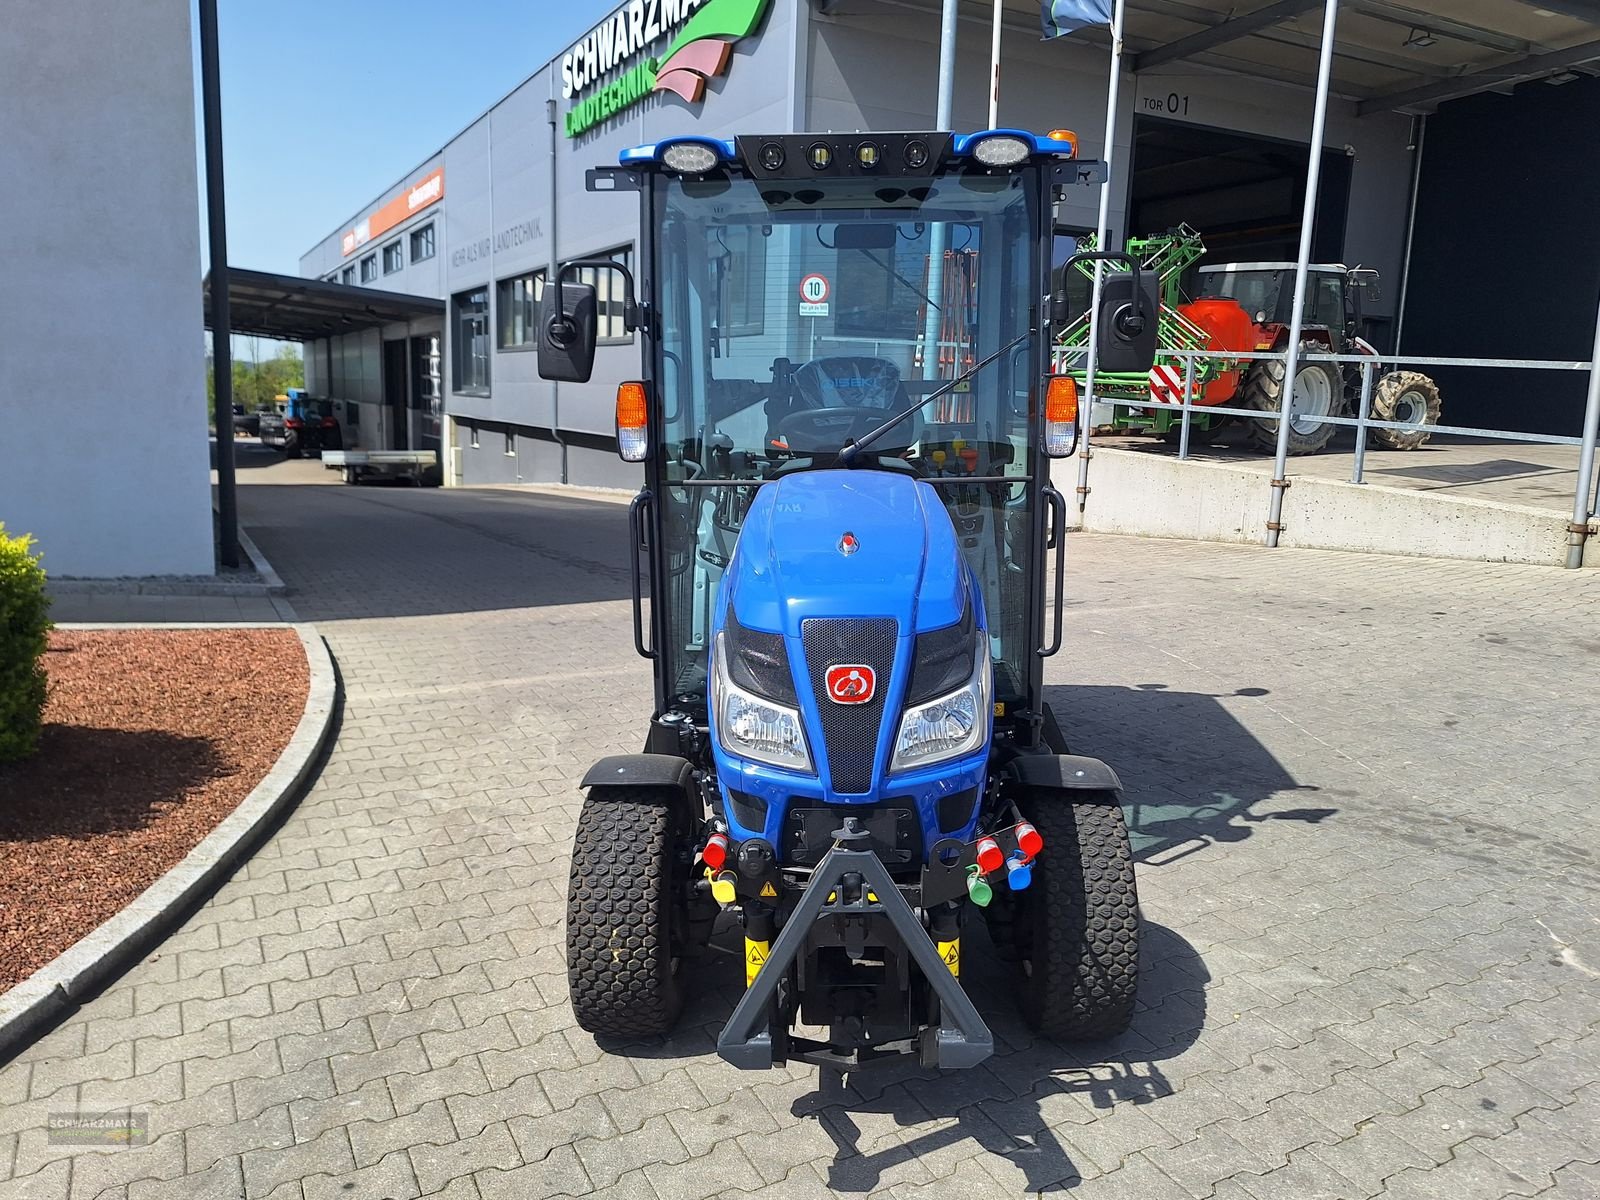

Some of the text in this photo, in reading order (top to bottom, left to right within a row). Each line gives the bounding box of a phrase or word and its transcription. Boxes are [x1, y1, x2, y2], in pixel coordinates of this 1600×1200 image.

[562, 0, 701, 99] SCHWARZM
[564, 57, 658, 138] LANDTECHNIK
[1143, 93, 1189, 116] TOR 01
[809, 281, 821, 297] 10
